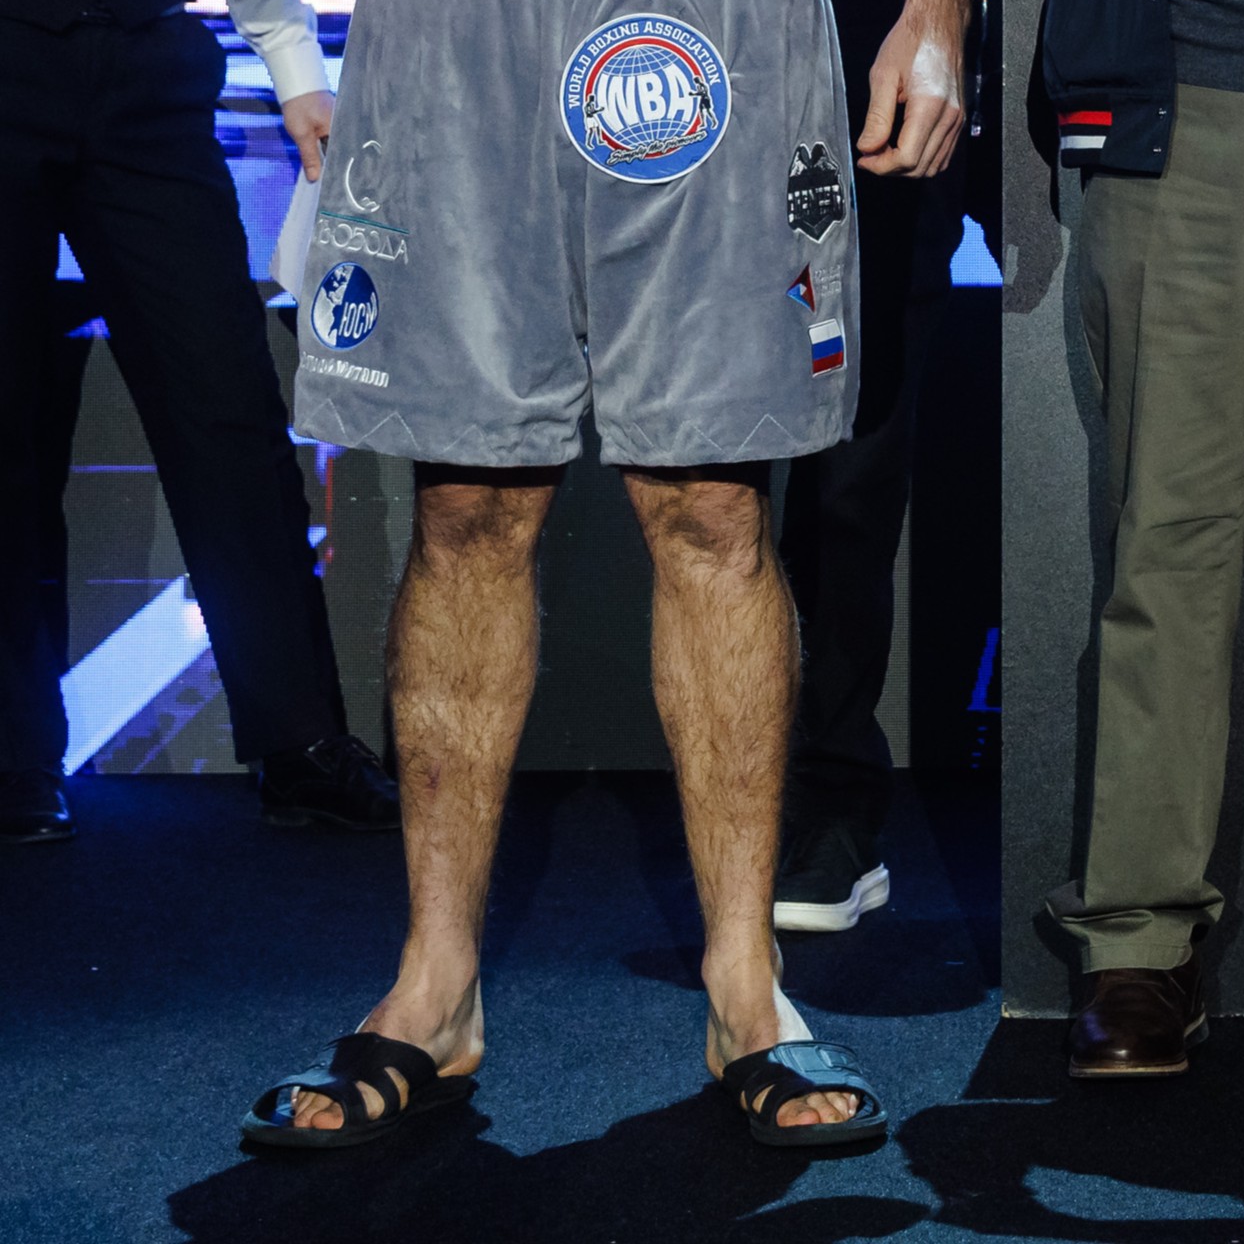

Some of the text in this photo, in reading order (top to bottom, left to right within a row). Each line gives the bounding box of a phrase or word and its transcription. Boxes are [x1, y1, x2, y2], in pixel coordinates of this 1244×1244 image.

[568, 21, 722, 109] WORLD BOXING ASSOCIATION
[597, 63, 695, 133] WBA
